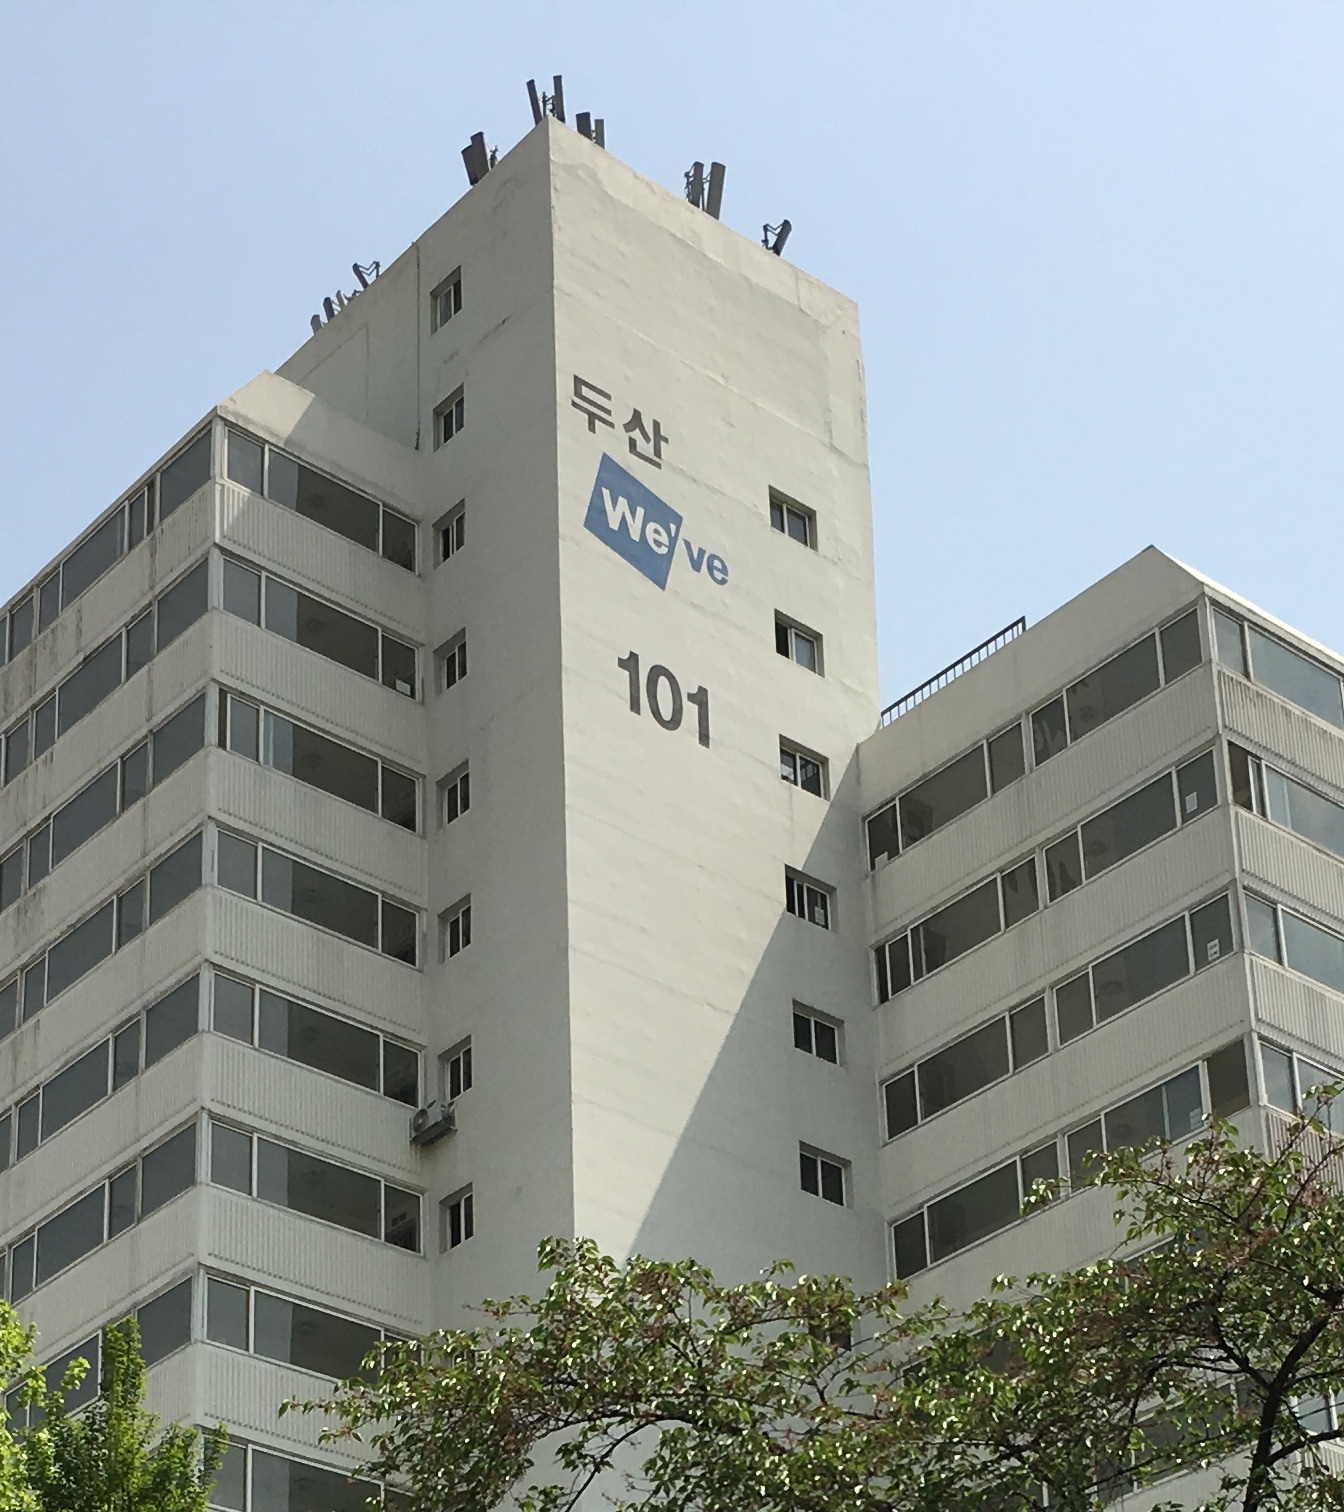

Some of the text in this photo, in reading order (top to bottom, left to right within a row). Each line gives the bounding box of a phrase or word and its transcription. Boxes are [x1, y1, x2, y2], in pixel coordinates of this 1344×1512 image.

[571, 374, 669, 470] 두산
[601, 487, 729, 586] We've
[617, 650, 711, 749] 101
